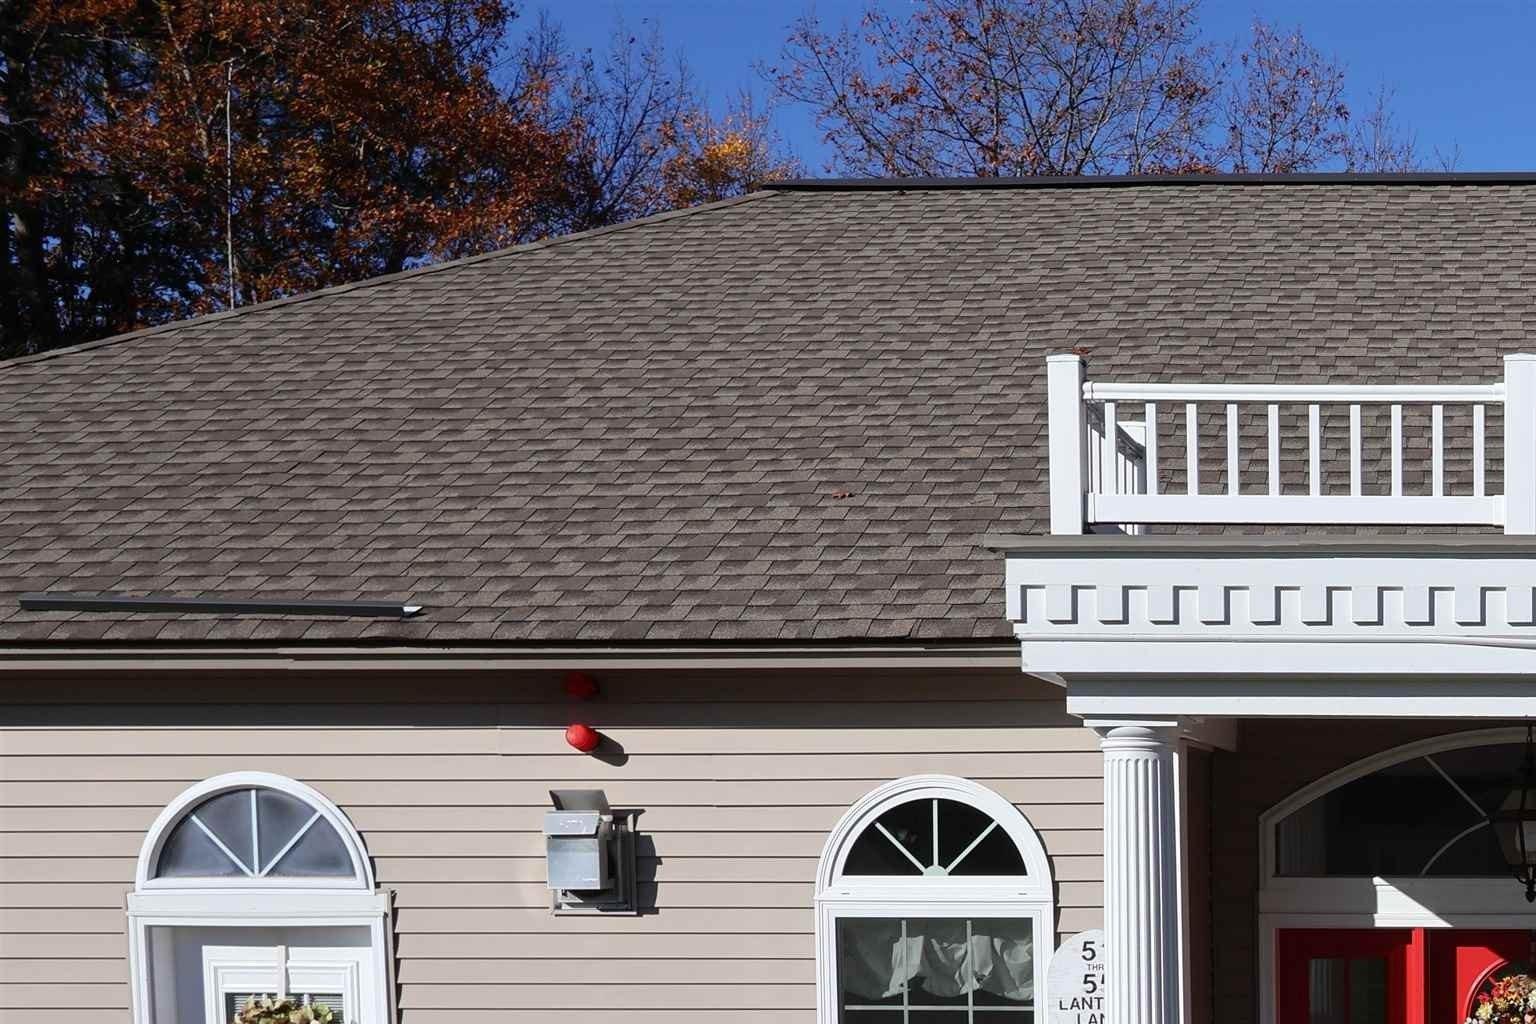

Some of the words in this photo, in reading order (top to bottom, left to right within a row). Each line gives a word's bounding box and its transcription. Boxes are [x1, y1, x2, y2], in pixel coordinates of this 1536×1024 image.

[1081, 941, 1104, 961] 5
[1083, 974, 1104, 994] 5
[1059, 997, 1104, 1010] LANT
